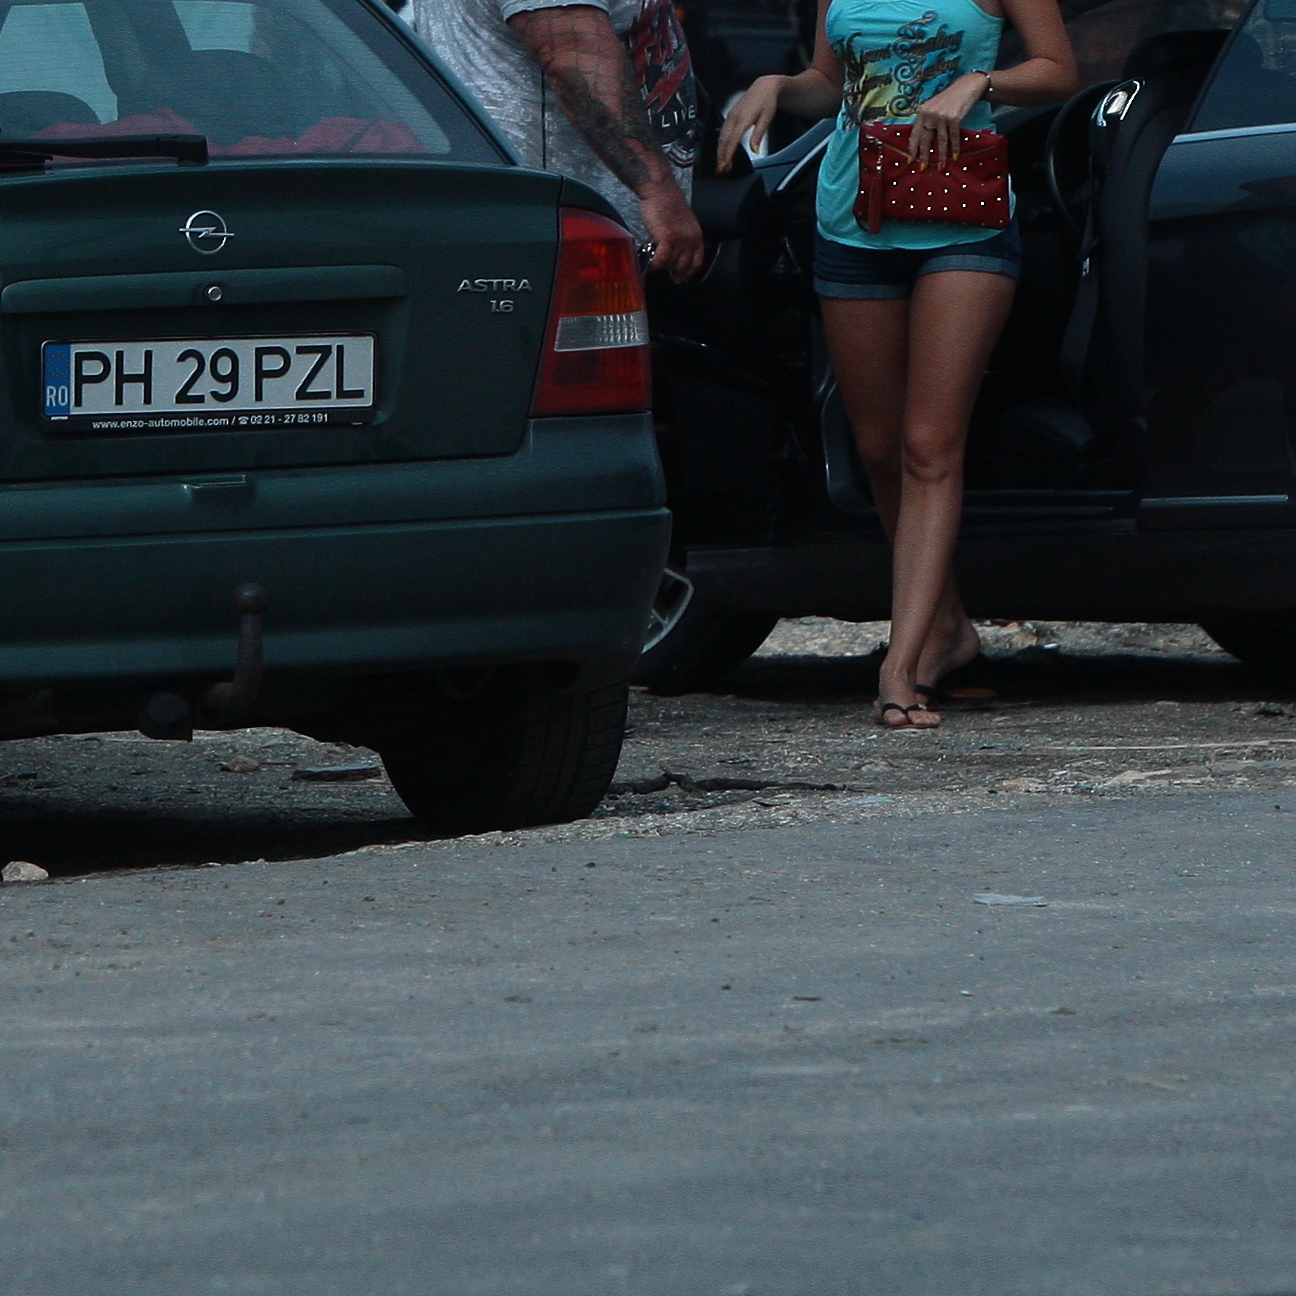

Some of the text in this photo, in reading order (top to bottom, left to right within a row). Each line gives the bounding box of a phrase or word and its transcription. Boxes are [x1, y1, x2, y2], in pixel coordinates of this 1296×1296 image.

[456, 278, 534, 292] ASTRA
[490, 299, 514, 313] 1.6
[72, 344, 365, 407] PH 29 PZL
[46, 384, 69, 407] RO
[92, 416, 229, 429] www.enzo-automobile.com
